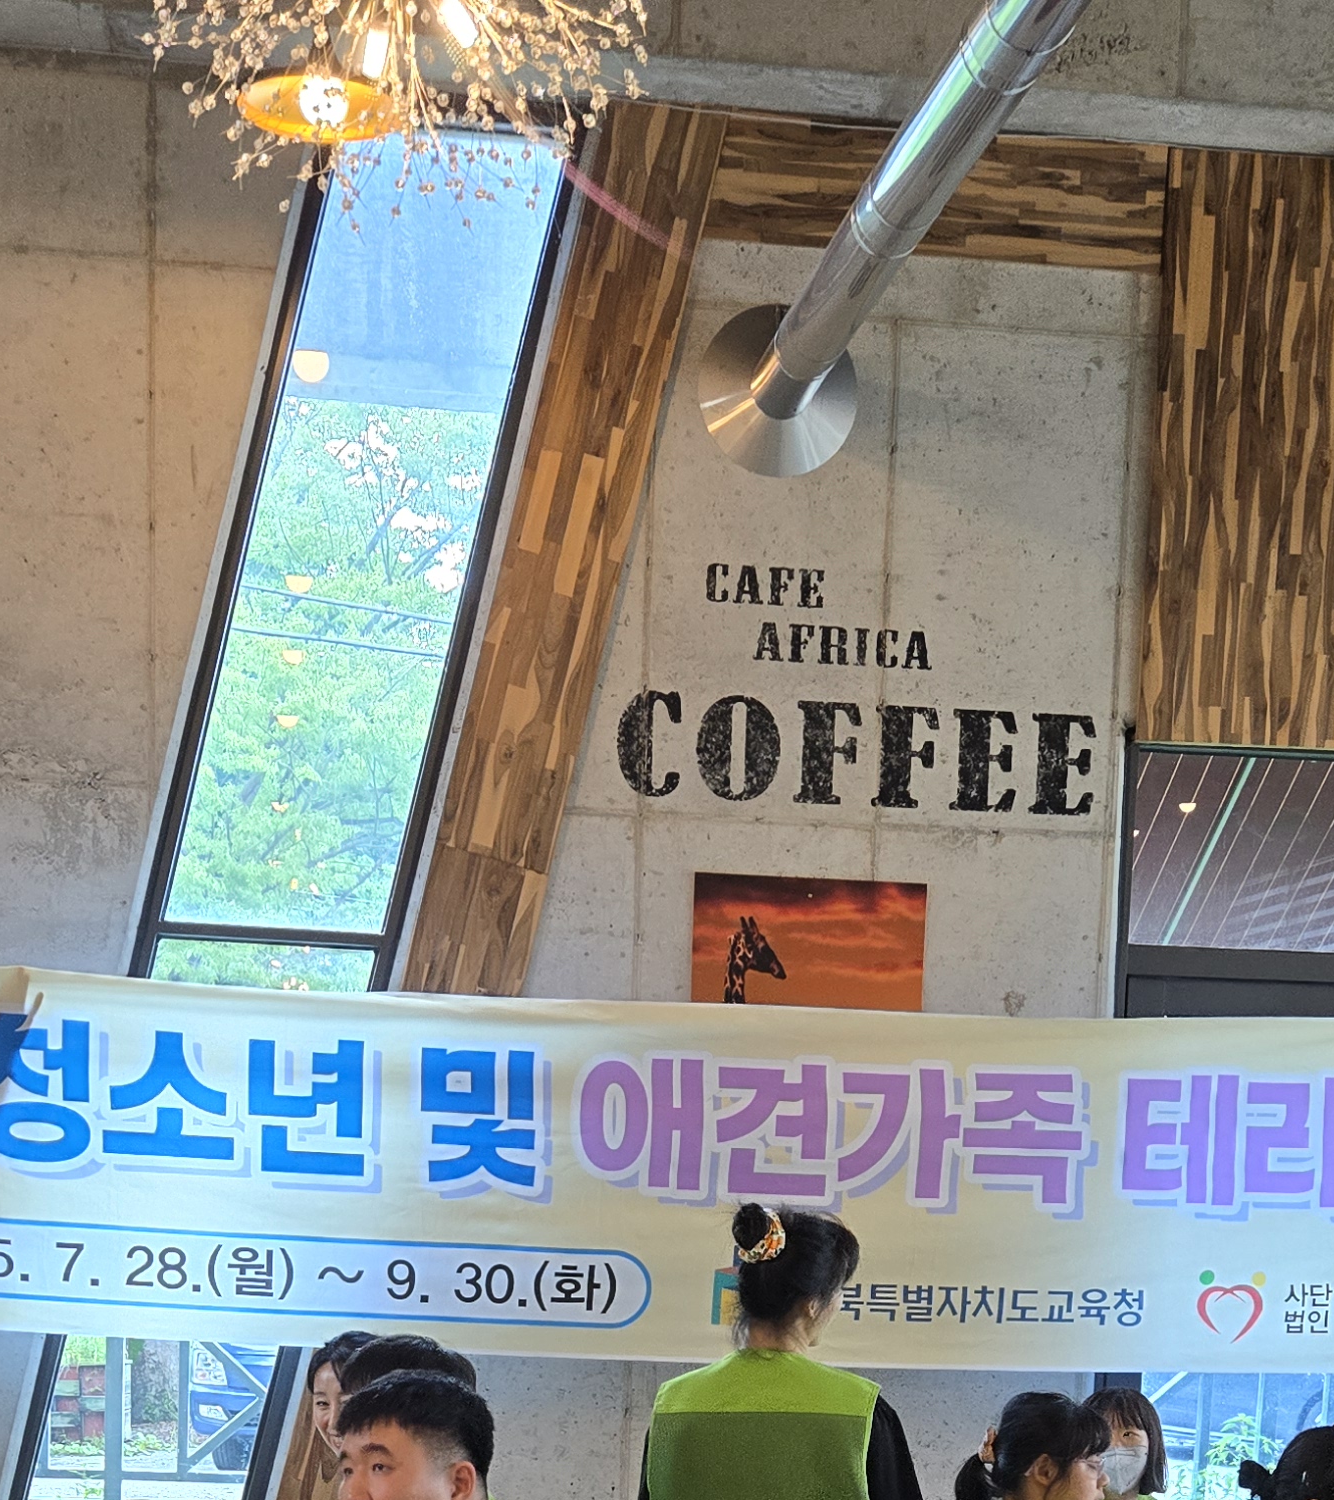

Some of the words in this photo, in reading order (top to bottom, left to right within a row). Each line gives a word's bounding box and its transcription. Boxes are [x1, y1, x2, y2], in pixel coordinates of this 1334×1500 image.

[705, 563, 825, 608] CAFE
[752, 621, 932, 670] AFRICA
[616, 690, 1097, 816] COFFEE
[418, 1045, 537, 1192] 및
[578, 1056, 1084, 1206] 애견가족
[55, 1240, 101, 1288] 7.
[125, 1244, 294, 1299] 28.(월)
[386, 1258, 430, 1303] 9.
[454, 1260, 617, 1314] 30.(화)
[1284, 1283, 1333, 1308] 사단
[839, 1283, 1145, 1328] 북특별자치도교육청
[1284, 1310, 1330, 1334] 법인
